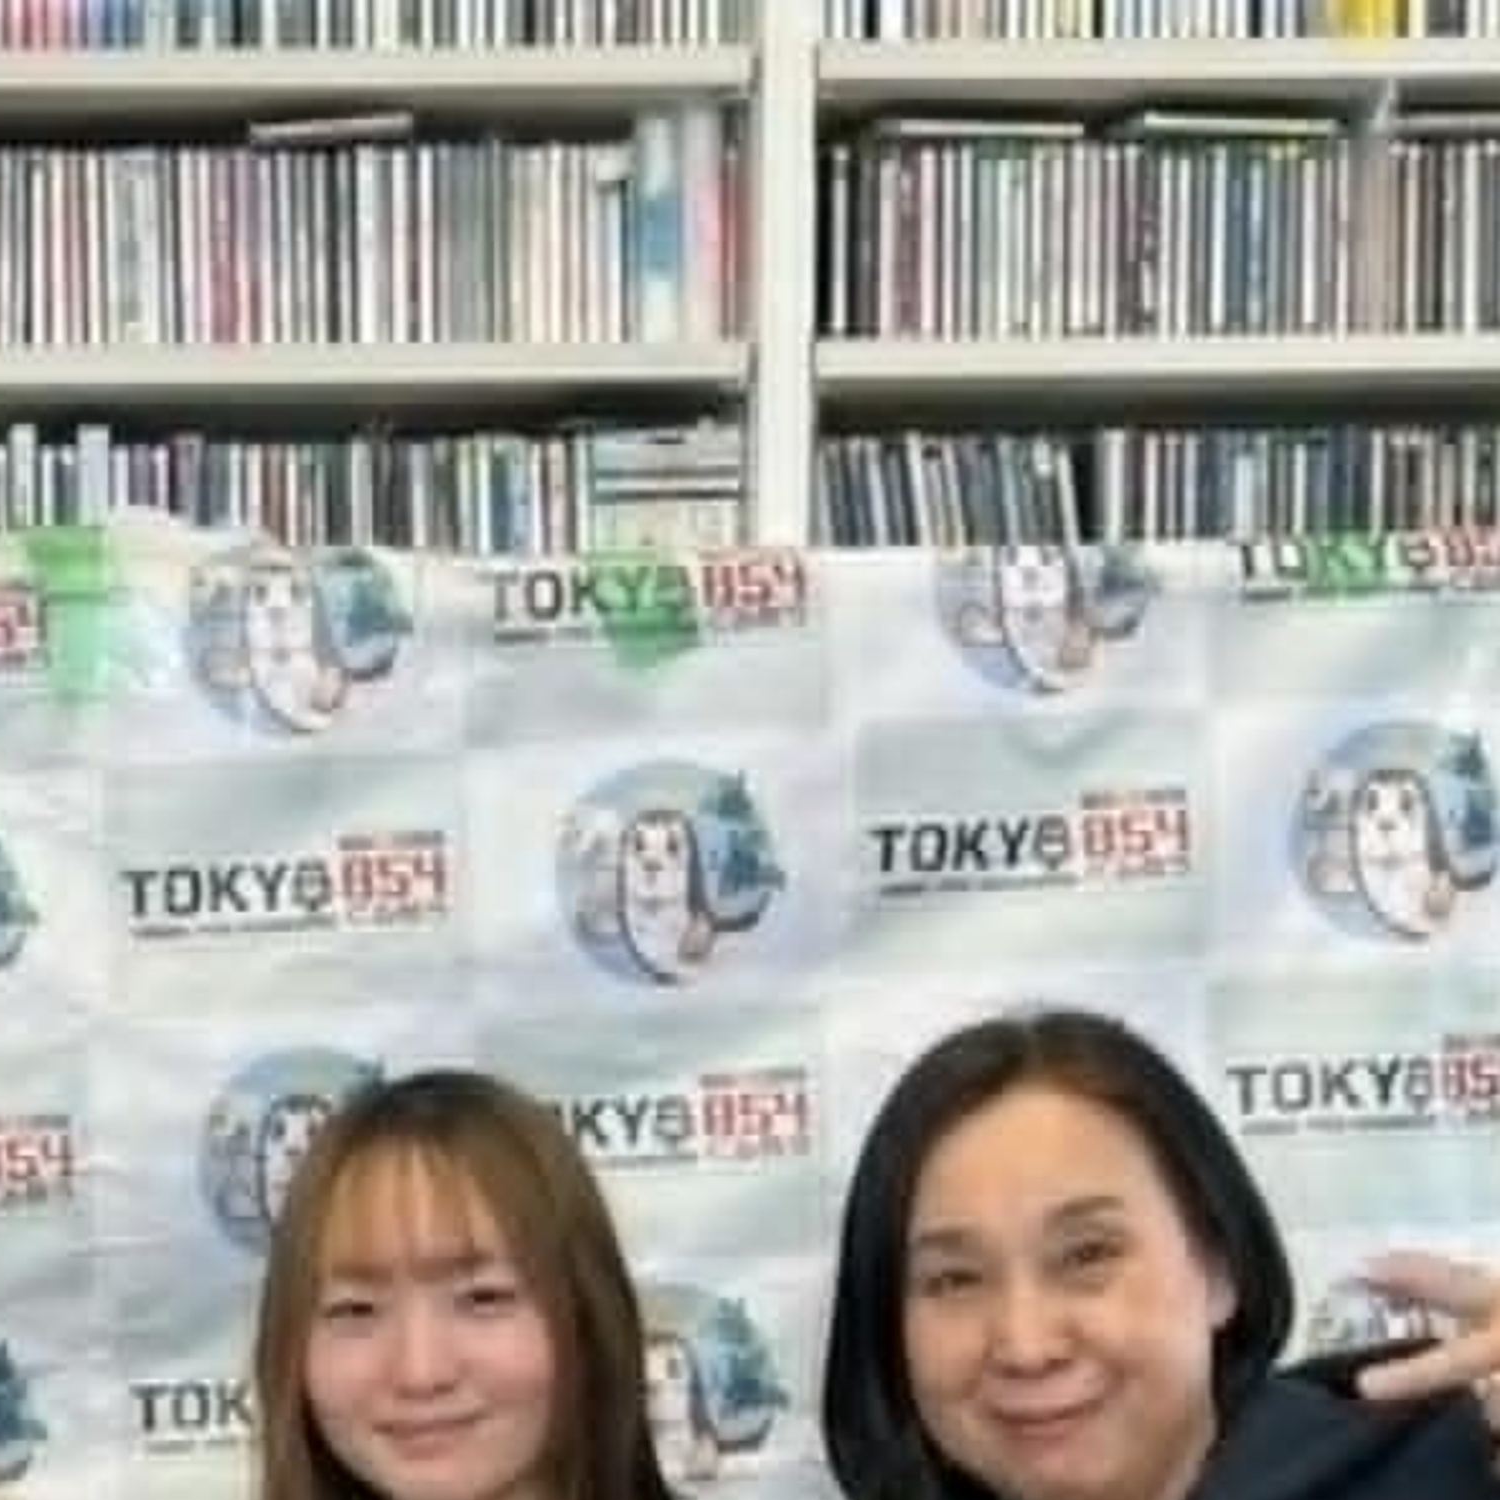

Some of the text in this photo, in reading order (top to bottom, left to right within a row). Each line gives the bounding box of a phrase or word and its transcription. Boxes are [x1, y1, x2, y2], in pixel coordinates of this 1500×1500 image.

[868, 813, 1071, 873] TOKYO
[119, 858, 331, 918] TOKYO
[1225, 1056, 1431, 1116] TOKYO
[554, 1094, 696, 1147] KYO
